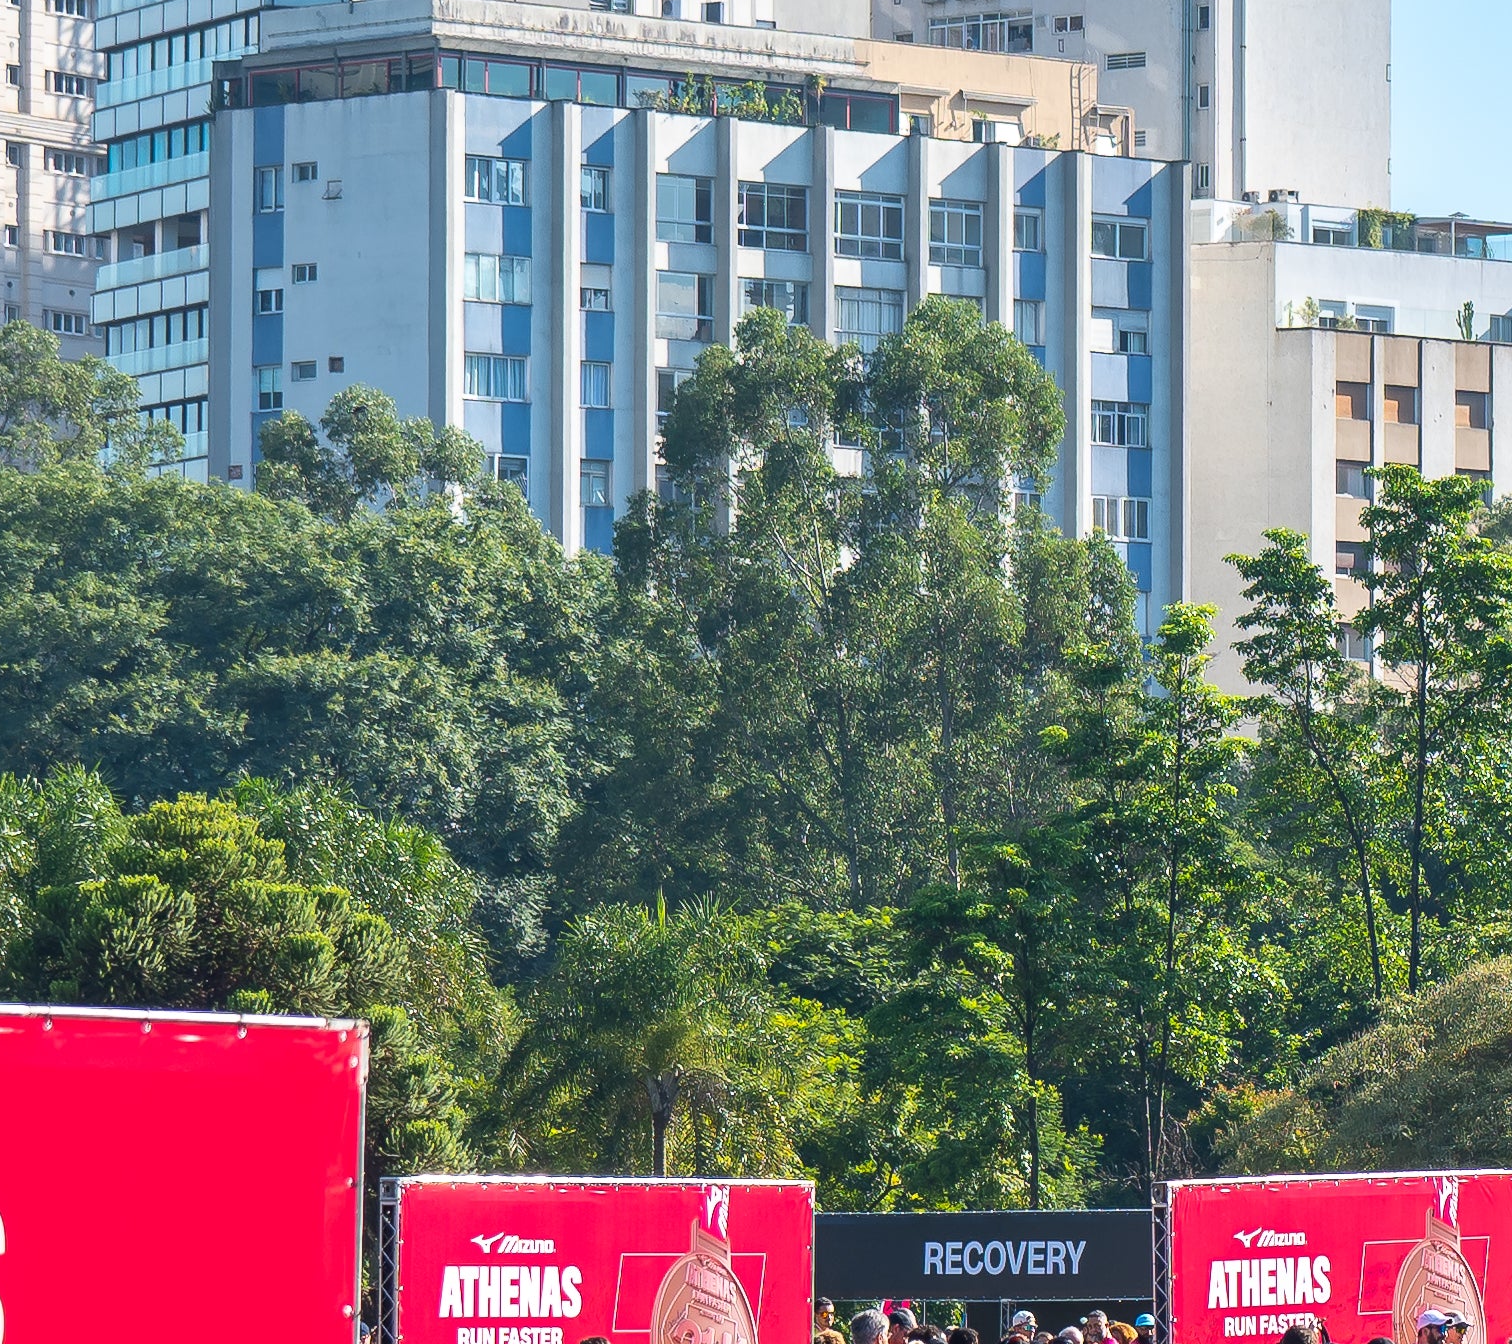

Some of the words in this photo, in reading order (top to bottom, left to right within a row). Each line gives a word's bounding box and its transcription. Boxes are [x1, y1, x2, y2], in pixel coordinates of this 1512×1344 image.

[924, 1240, 1087, 1276] RECOVERY
[439, 1265, 584, 1319] ATHENAS
[1208, 1255, 1332, 1309] ATHENAS
[1223, 1316, 1257, 1337] RUN
